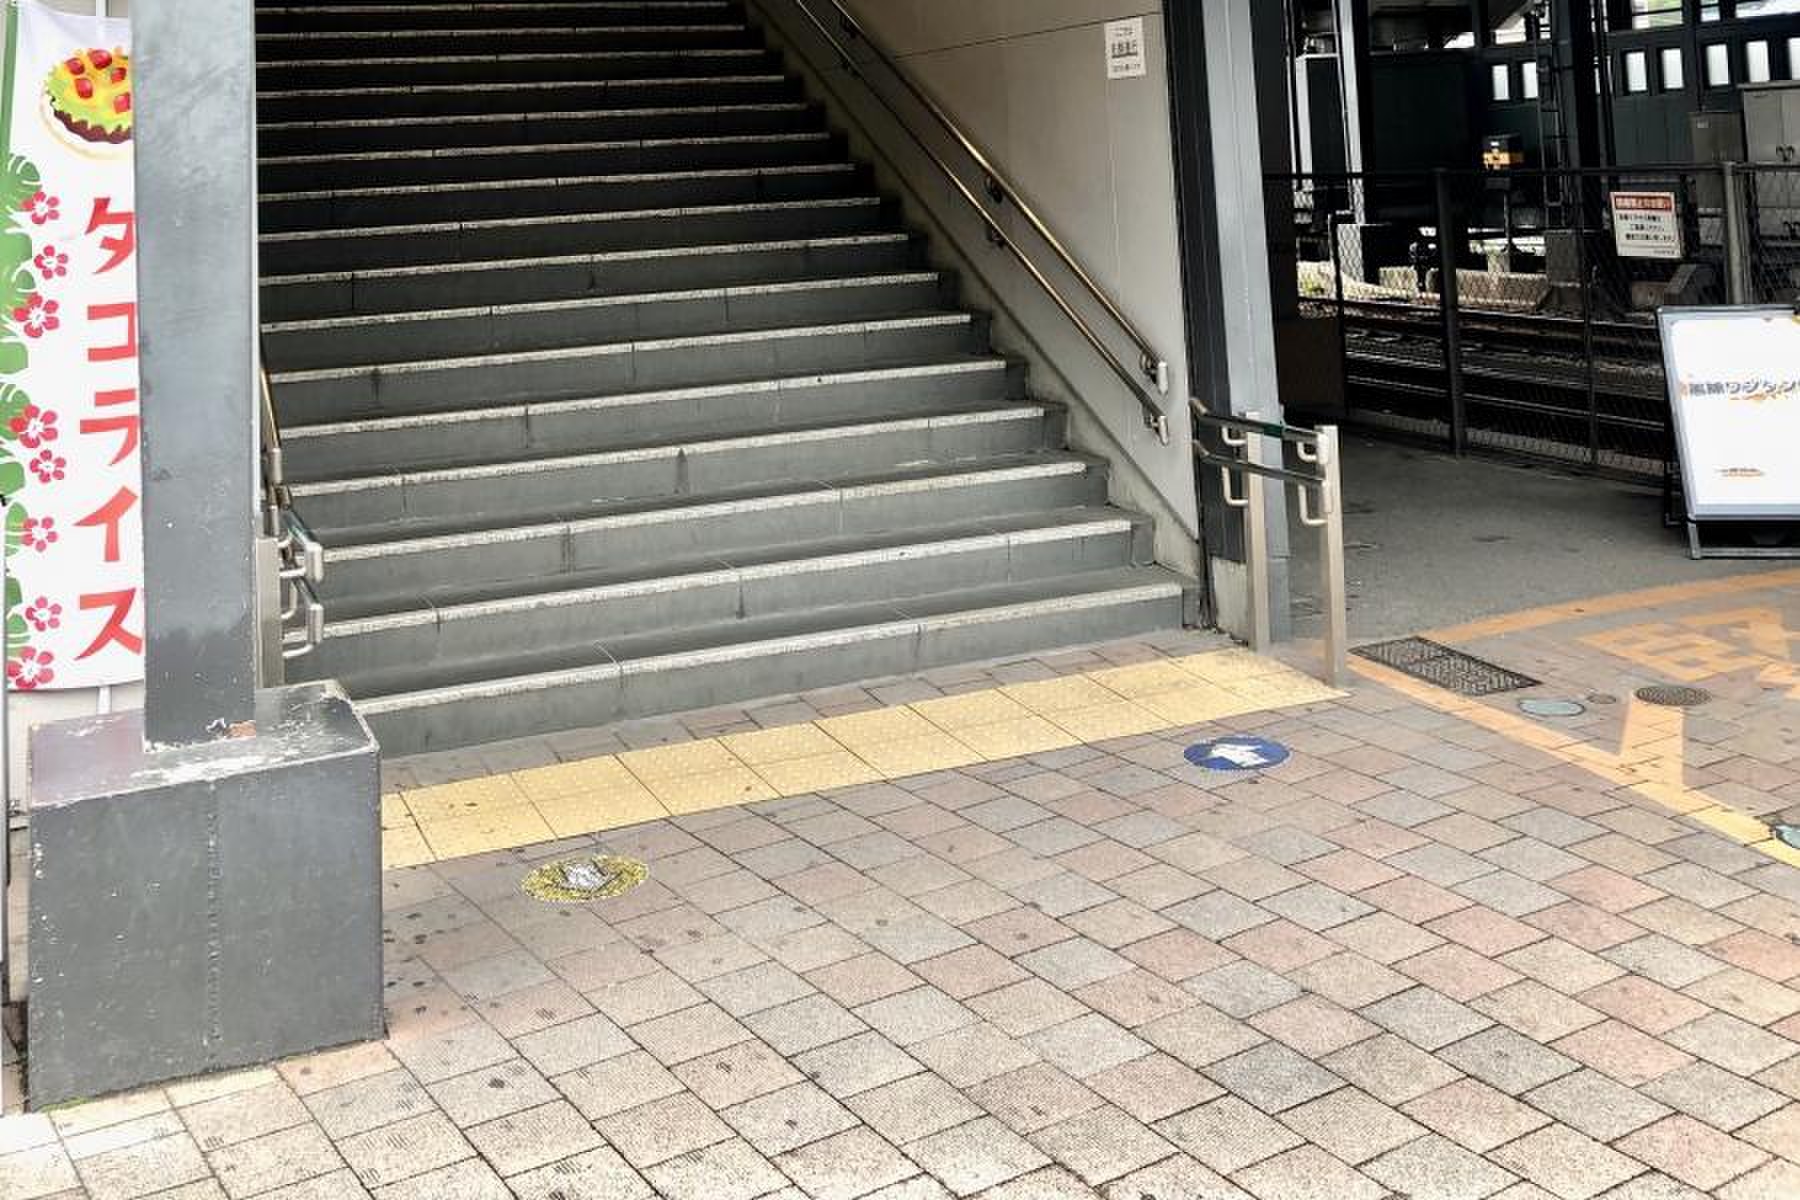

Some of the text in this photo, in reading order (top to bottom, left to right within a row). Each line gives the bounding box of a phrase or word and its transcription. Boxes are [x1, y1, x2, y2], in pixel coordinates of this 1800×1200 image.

[73, 196, 143, 662] タコライス
